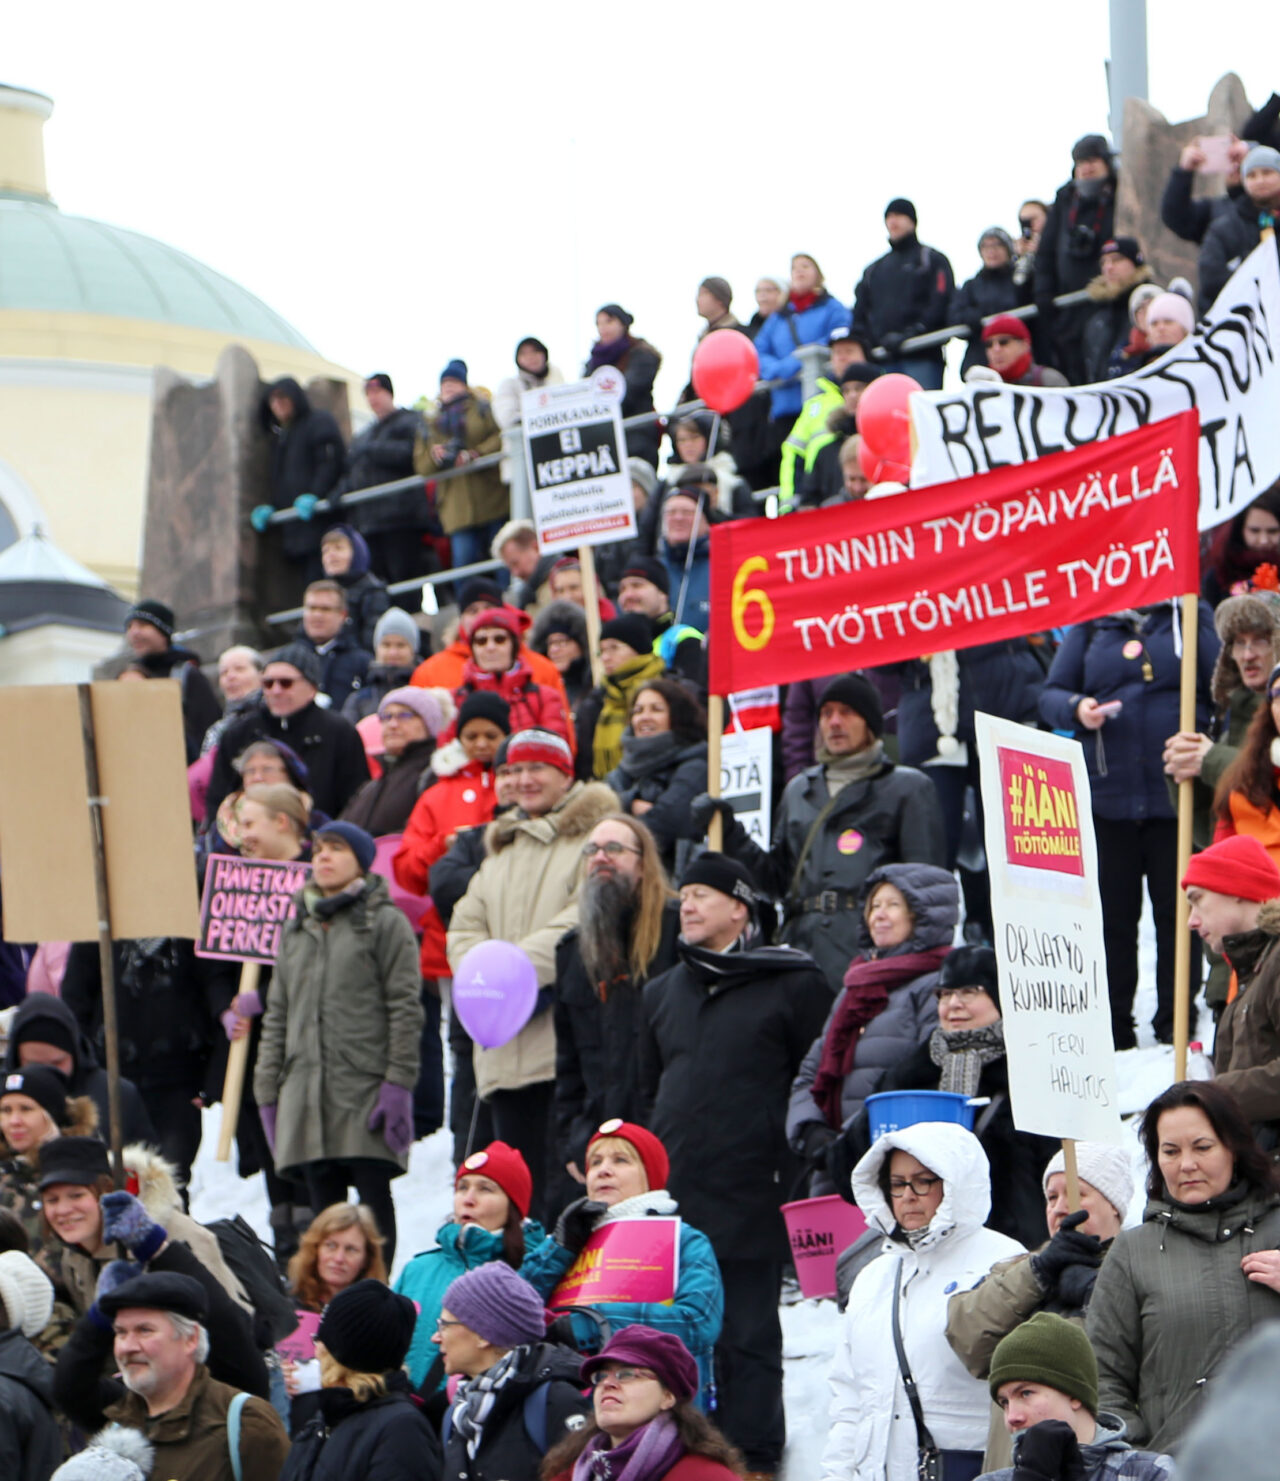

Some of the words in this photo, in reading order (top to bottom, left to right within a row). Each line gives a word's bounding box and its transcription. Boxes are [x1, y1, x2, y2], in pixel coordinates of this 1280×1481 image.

[536, 444, 618, 487] KEPPIÄ
[559, 427, 583, 454] EI
[731, 555, 776, 652] 6
[776, 526, 915, 583] TUNNIN
[922, 447, 1179, 553] TYÖPÄIVÄLLÄ
[793, 569, 1051, 652] TYÖTTÖMILLE
[1057, 527, 1175, 598] TYÖTÄ
[1008, 762, 1078, 829] #ÄÄNI
[1005, 922, 1084, 975] ORJATYÖ
[1050, 1063, 1110, 1108] HALLITUS
